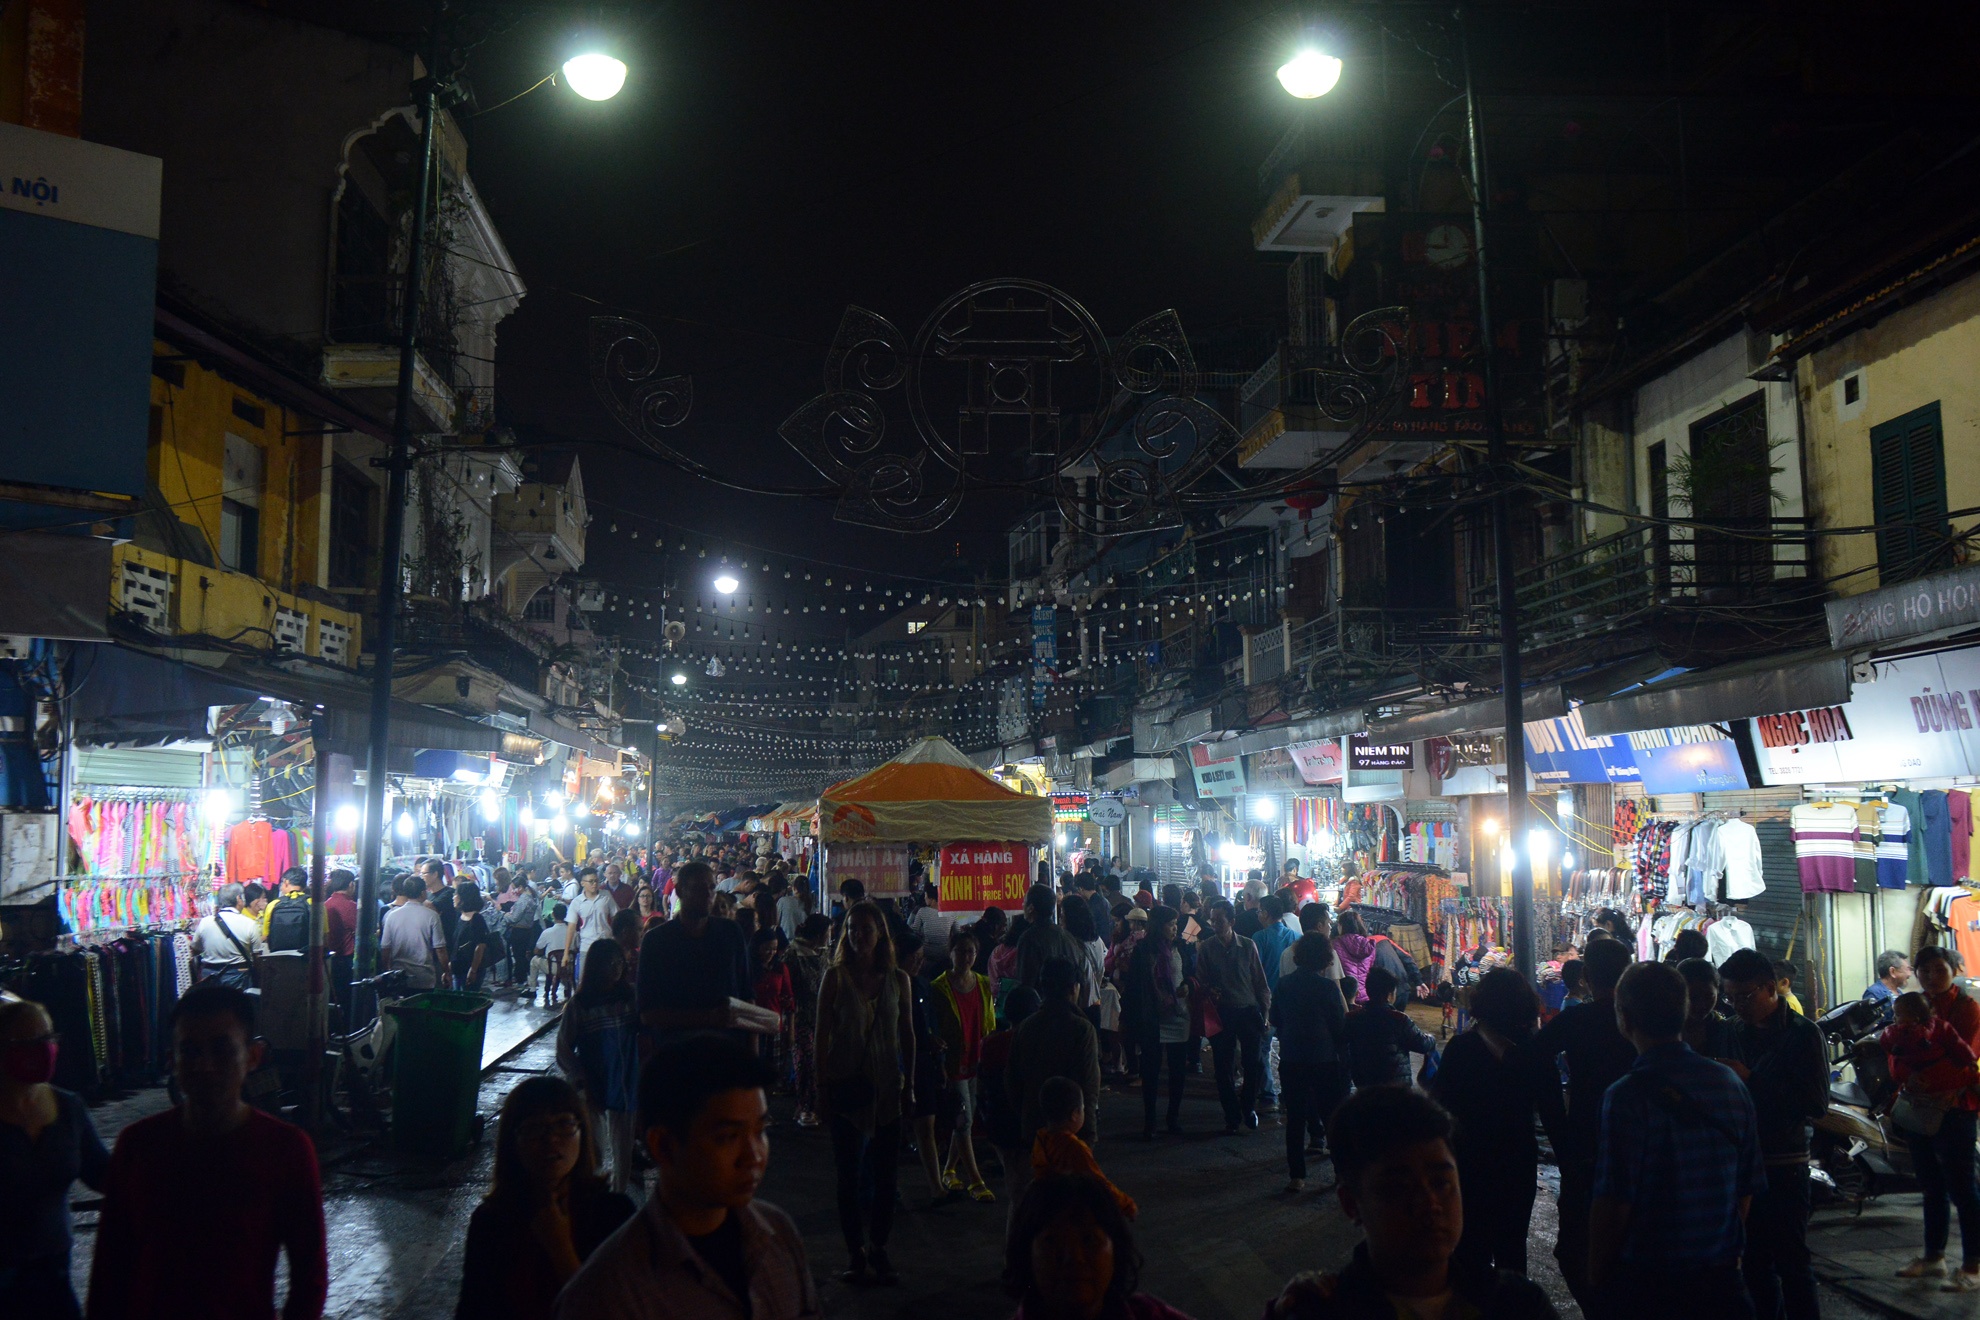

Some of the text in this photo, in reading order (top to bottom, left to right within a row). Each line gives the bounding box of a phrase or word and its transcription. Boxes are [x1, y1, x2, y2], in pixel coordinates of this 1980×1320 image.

[12, 176, 59, 206] NỘI
[1909, 686, 1973, 733] DŨNG
[1757, 711, 1810, 754] NGỌC
[1806, 705, 1854, 743] HOA
[1389, 745, 1410, 756] TIN
[508, 852, 518, 863] 50
[950, 849, 1013, 865] XẢ HÀNG
[941, 870, 973, 901] KÍNH
[982, 890, 1002, 901] PRICE
[1005, 874, 1026, 900] 50K
